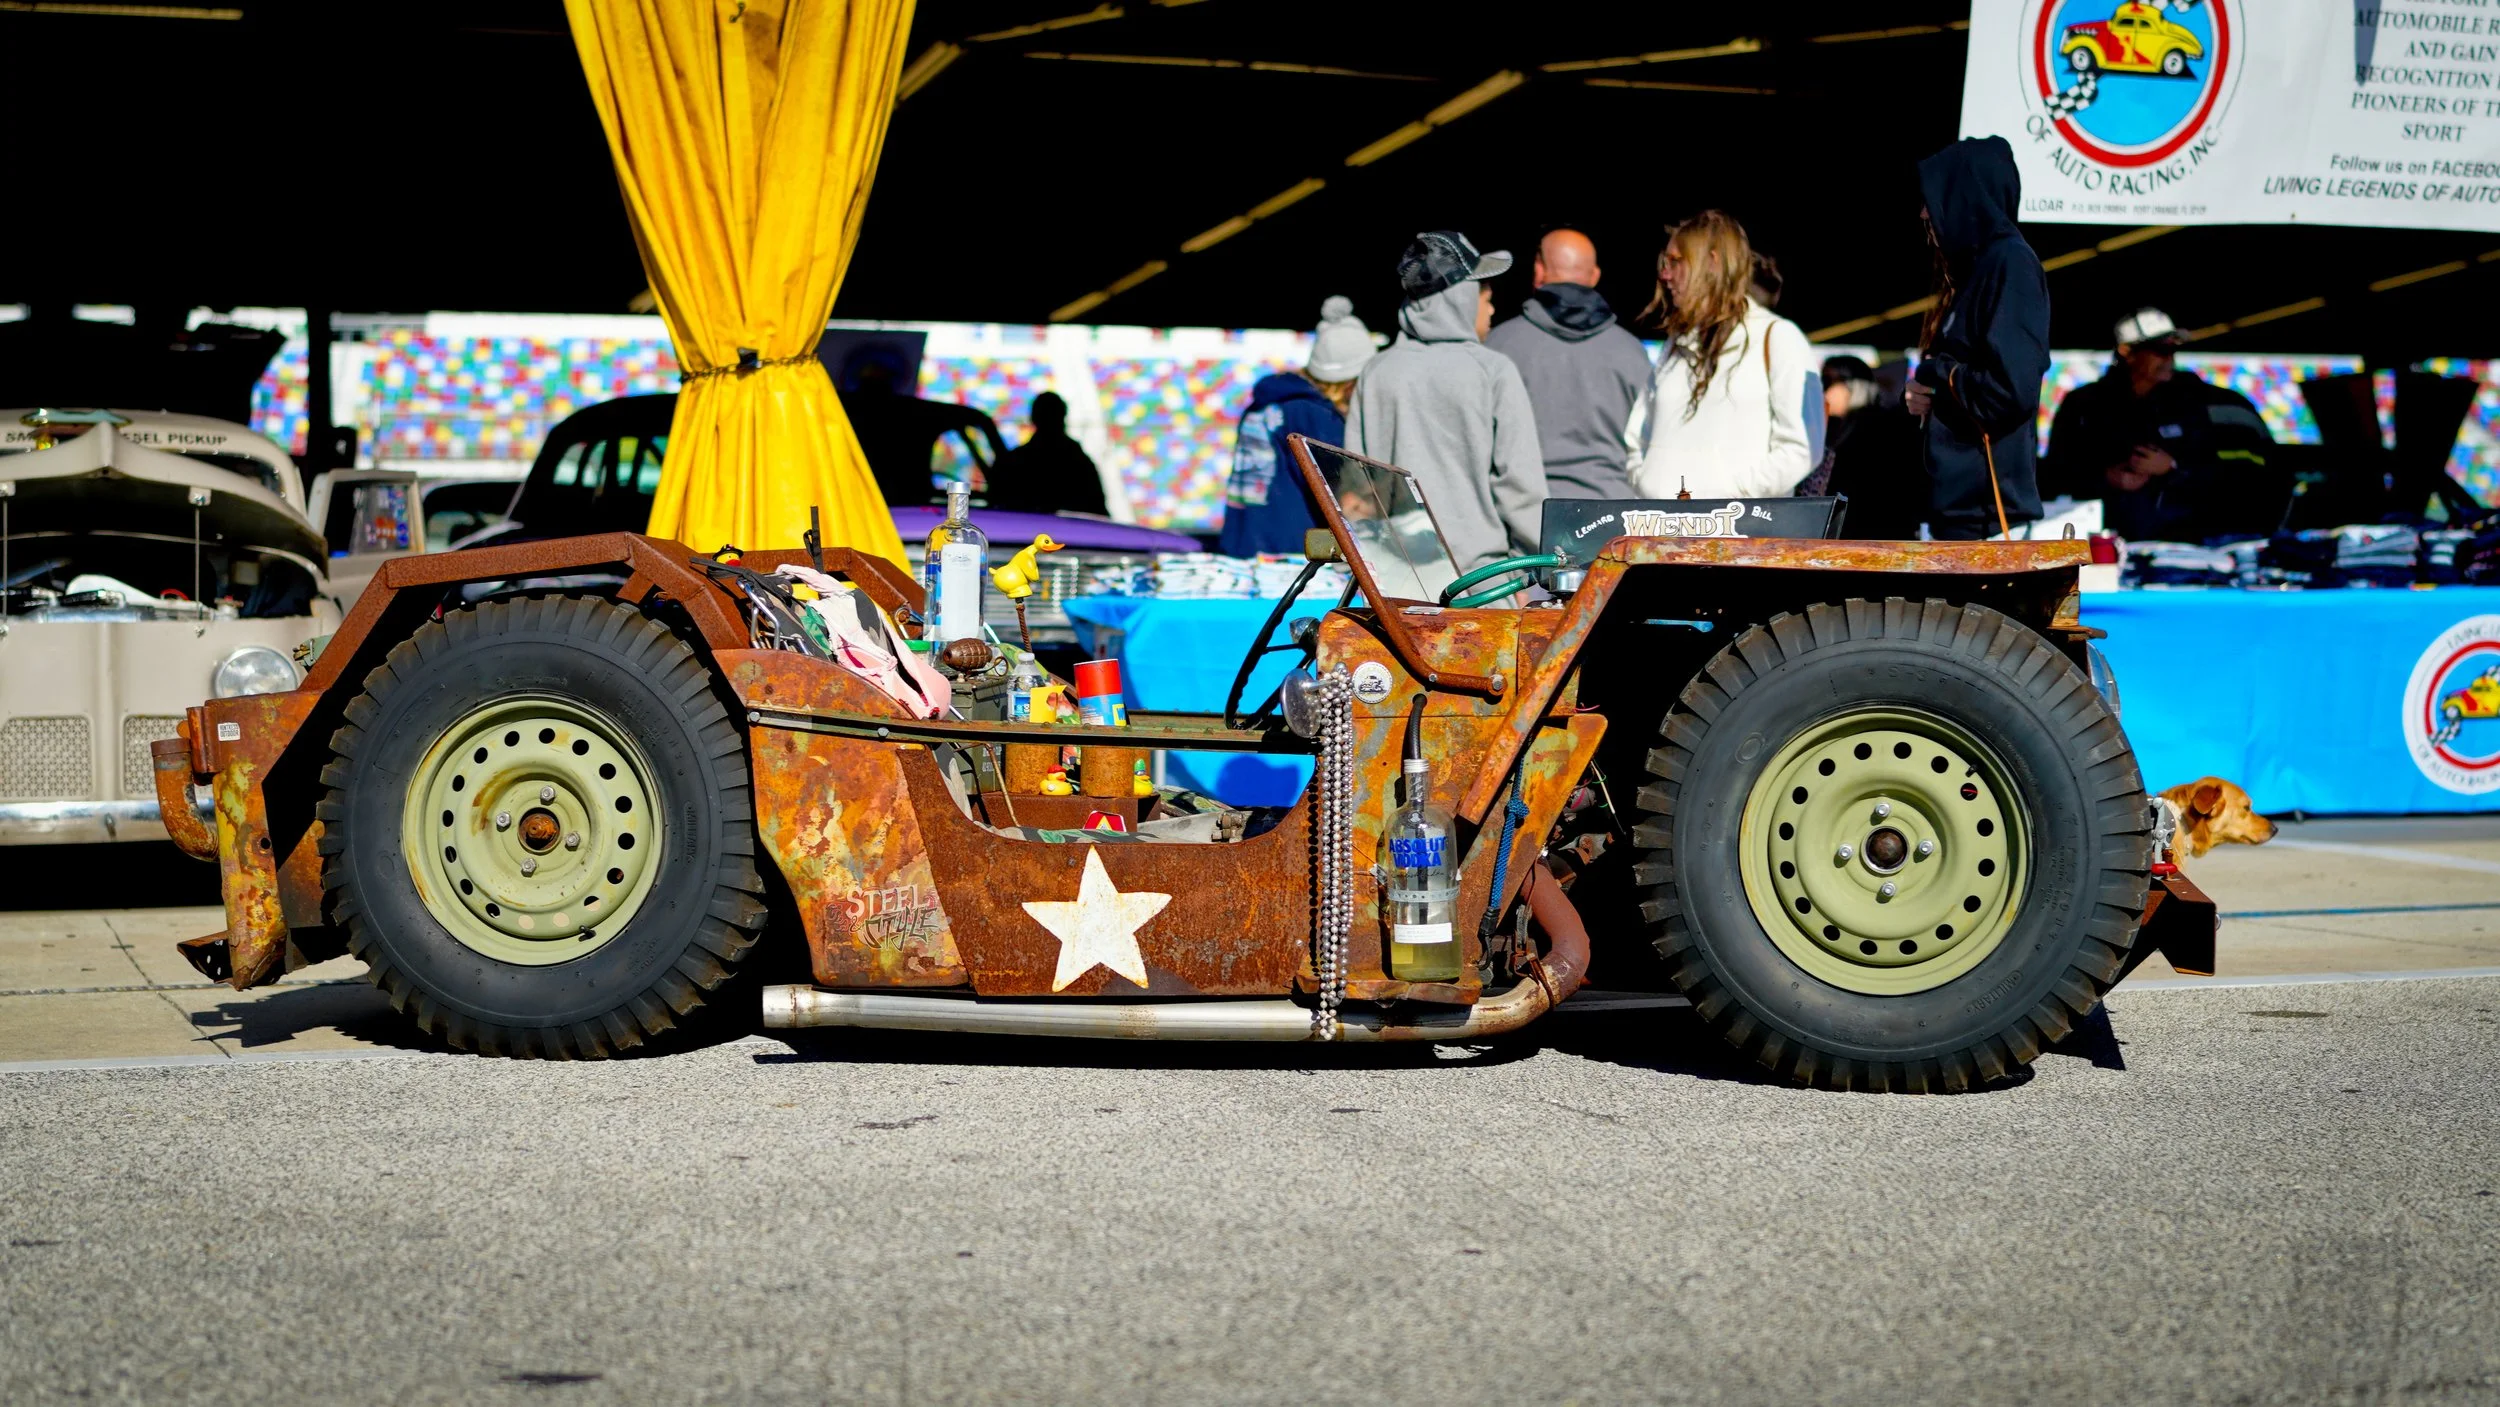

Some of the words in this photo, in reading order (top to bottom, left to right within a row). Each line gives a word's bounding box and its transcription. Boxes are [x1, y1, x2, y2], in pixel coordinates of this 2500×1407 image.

[2354, 8, 2483, 34] AUTOMOBILE
[2403, 41, 2447, 59] AND
[2450, 44, 2500, 62] GAIN
[2355, 64, 2493, 88] RECOGNITION
[2351, 91, 2447, 114] PIONEERS
[2451, 99, 2480, 116] OF
[2401, 122, 2466, 142] SPORT
[2026, 114, 2053, 143] OF
[2046, 146, 2103, 190] AUTO
[2331, 154, 2380, 172] Follow
[2385, 161, 2403, 174] us
[2407, 162, 2427, 175] on
[2264, 175, 2321, 195] LIVING
[2326, 178, 2418, 200] LEGENDS
[2422, 183, 2451, 201] OF
[2025, 199, 2064, 212] LLOAR
[167, 434, 228, 445] PICKUP
[1575, 514, 1615, 539] LEONARD
[1626, 503, 1741, 537] WENDT
[1389, 836, 1447, 853] ABSOLUT
[1393, 852, 1442, 867] VODKA
[845, 884, 930, 919] STEEL
[864, 906, 938, 952] STYLE
[1971, 977, 2017, 1016] MILITARY
